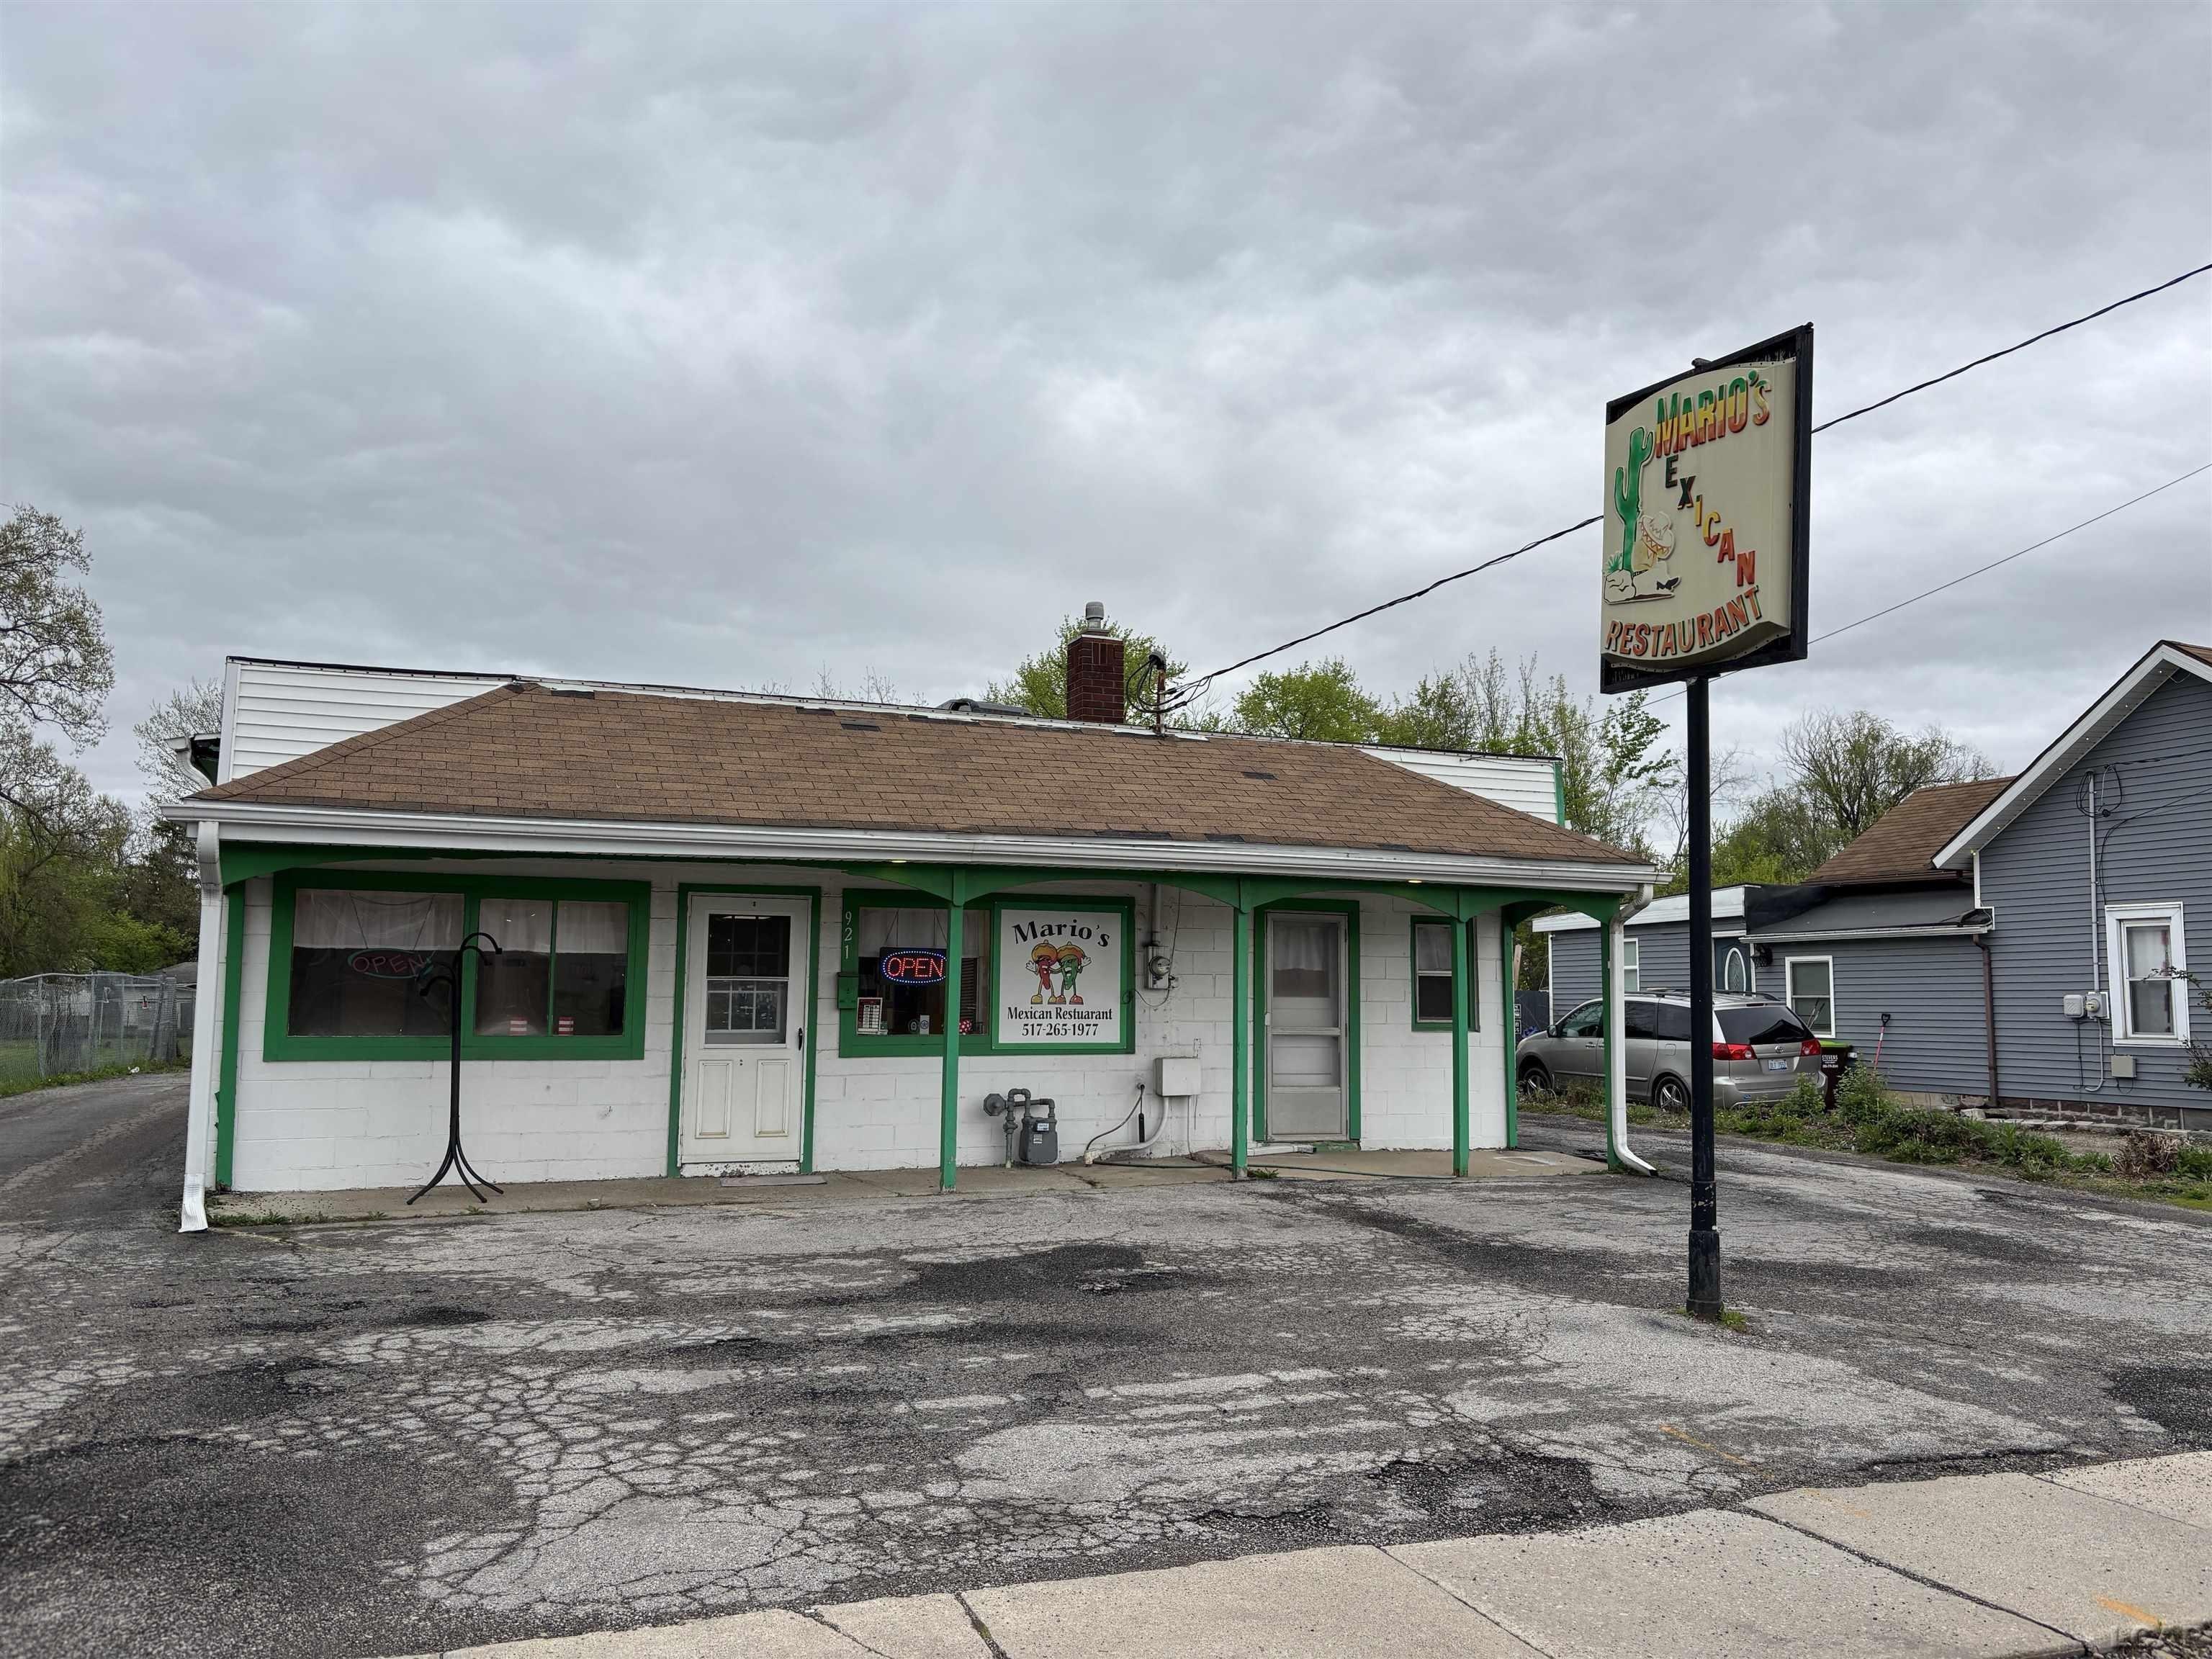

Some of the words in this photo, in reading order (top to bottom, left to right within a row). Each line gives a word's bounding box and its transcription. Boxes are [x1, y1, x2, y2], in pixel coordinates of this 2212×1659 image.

[1655, 369, 1772, 459] MARIO'S
[1605, 585, 1763, 657] RESTAURANT
[844, 911, 853, 959] 921
[1012, 919, 1110, 947] Mario's
[352, 954, 426, 976] OPEN
[887, 957, 943, 977] OPEN
[1007, 1007, 1052, 1020] Mexican
[1055, 1007, 1112, 1020] Restuarant
[1022, 1022, 1099, 1037] 517-265-1977
